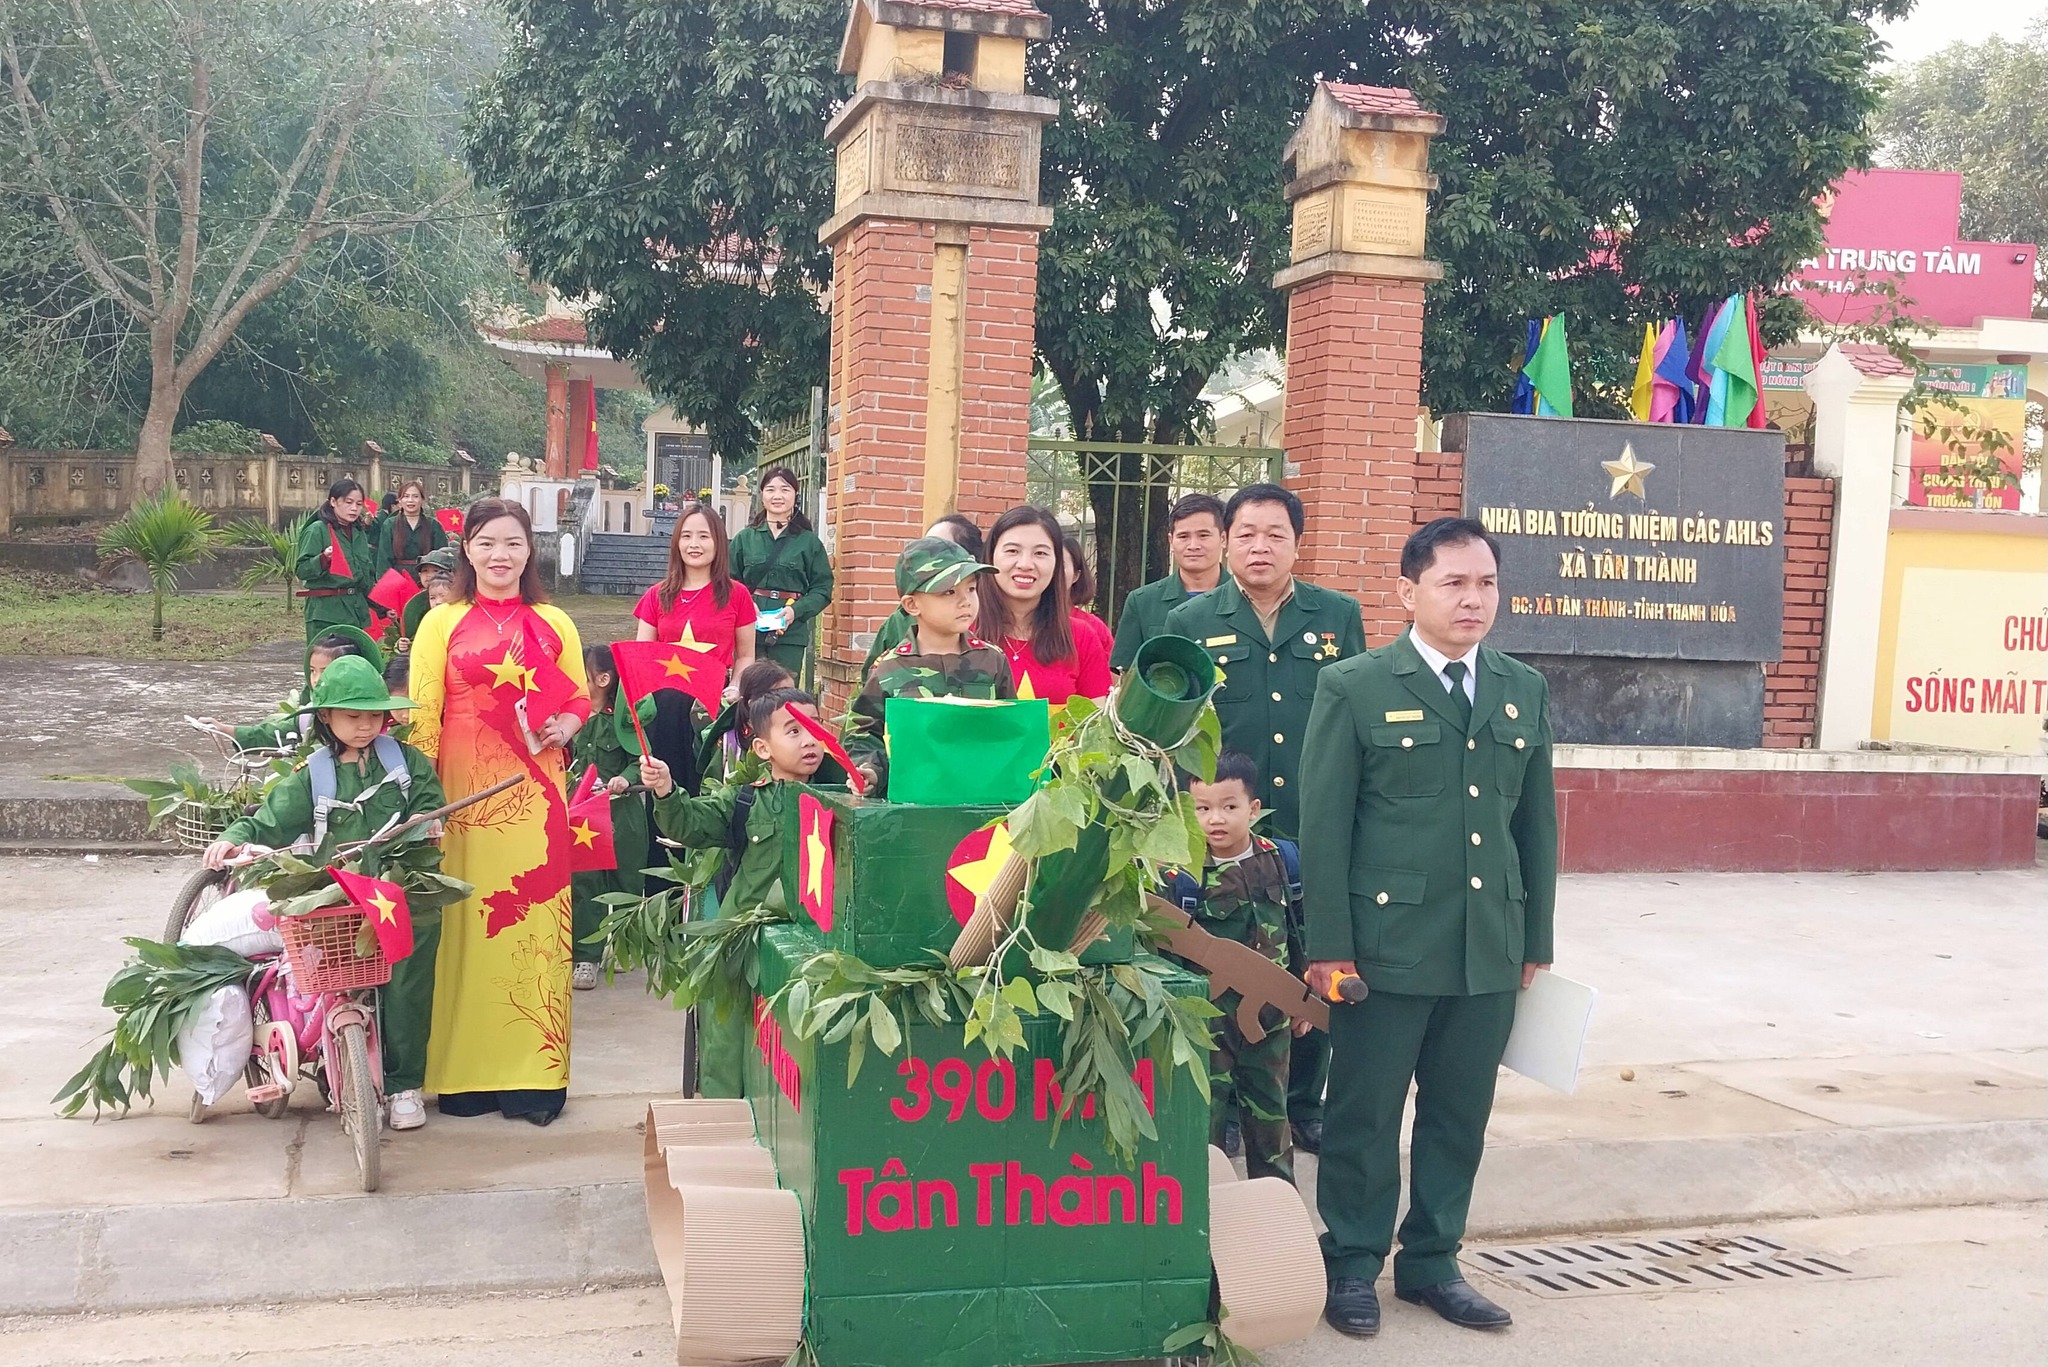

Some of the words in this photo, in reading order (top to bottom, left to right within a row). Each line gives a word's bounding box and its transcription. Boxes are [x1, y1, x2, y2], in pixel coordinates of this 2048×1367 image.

[1825, 247, 1916, 273] TRUNG
[1922, 245, 1981, 275] TÂM
[1769, 374, 1798, 386] NÔNG
[1523, 509, 1557, 536] BIA
[1560, 501, 1624, 539] TƯỞNG
[1628, 509, 1677, 547] NIỆM
[1682, 510, 1720, 544] CÁC
[1724, 519, 1773, 546] AHLS
[1560, 545, 1588, 579] XÃ
[1591, 548, 1629, 580] TÂN
[1634, 550, 1697, 583] THÀNH
[1535, 593, 1553, 615] XÃ
[1556, 594, 1581, 616] TÂN
[1666, 603, 1706, 622] THANH
[1710, 600, 1737, 622] HÓA
[1905, 667, 1976, 714] SỐNG
[1980, 670, 2027, 715] MÃI
[890, 1057, 1016, 1123] 390
[838, 1157, 960, 1237] Tân
[968, 1152, 1184, 1228] Thành
